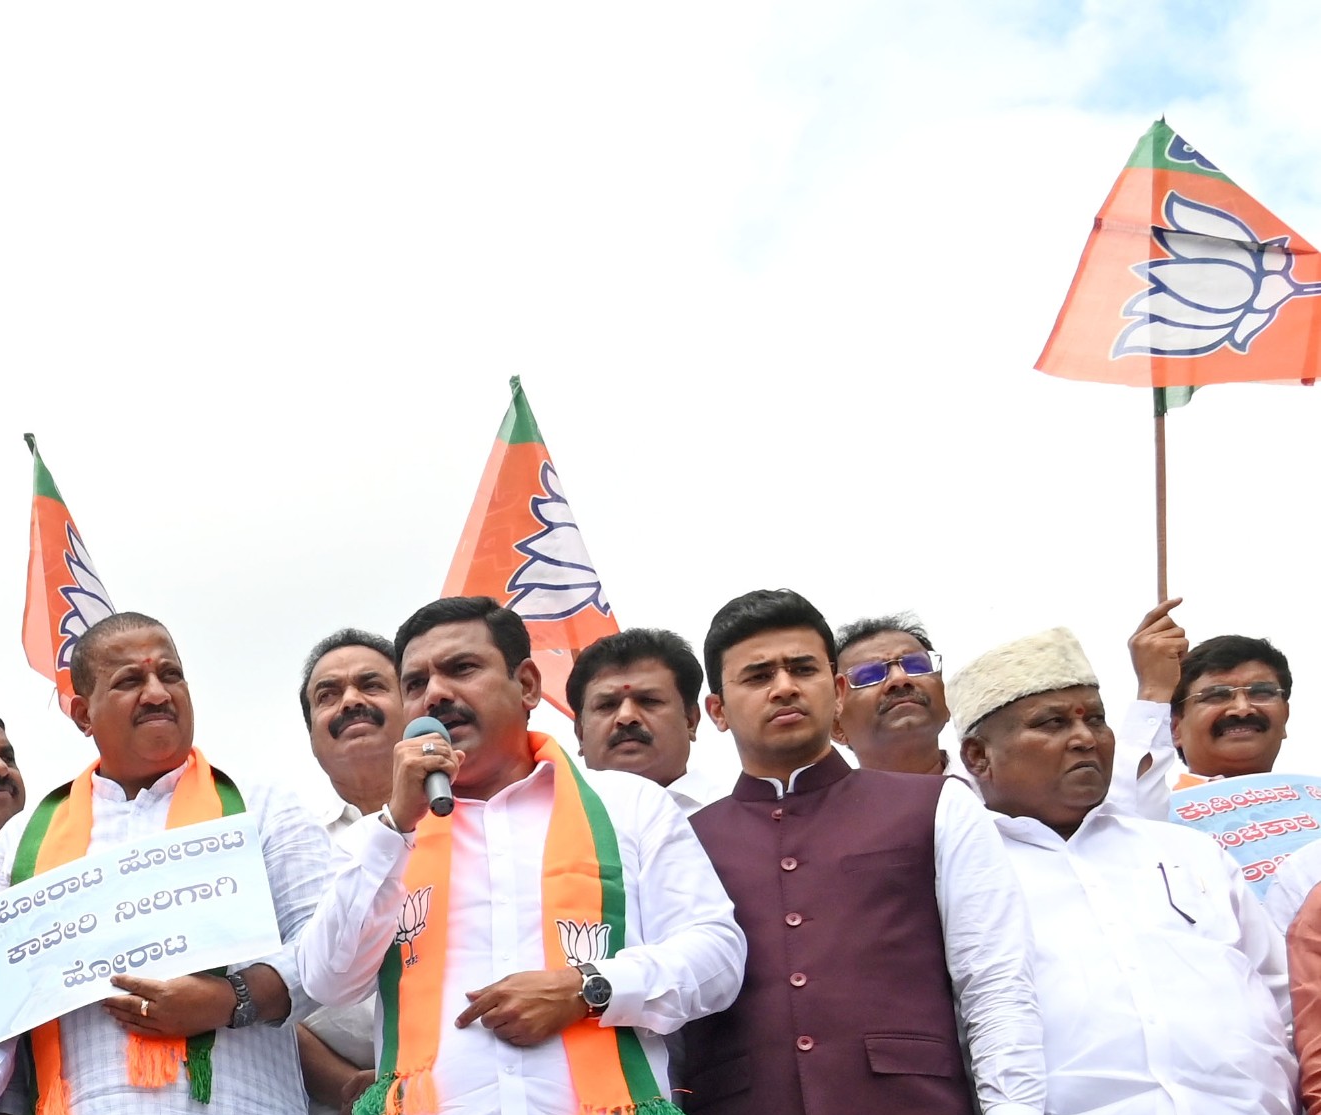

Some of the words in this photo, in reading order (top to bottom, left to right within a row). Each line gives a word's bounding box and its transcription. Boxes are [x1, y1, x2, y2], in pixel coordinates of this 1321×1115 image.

[1176, 784, 1300, 821] ಕುಡಿಯುವ
[118, 830, 245, 876] ಹೋರಾಟ
[7, 913, 98, 965] ಕಾವೇರಿ
[114, 875, 238, 924] ನೀರಿಗಾಗಿ
[62, 935, 188, 988] ಹೋರಾಟ
